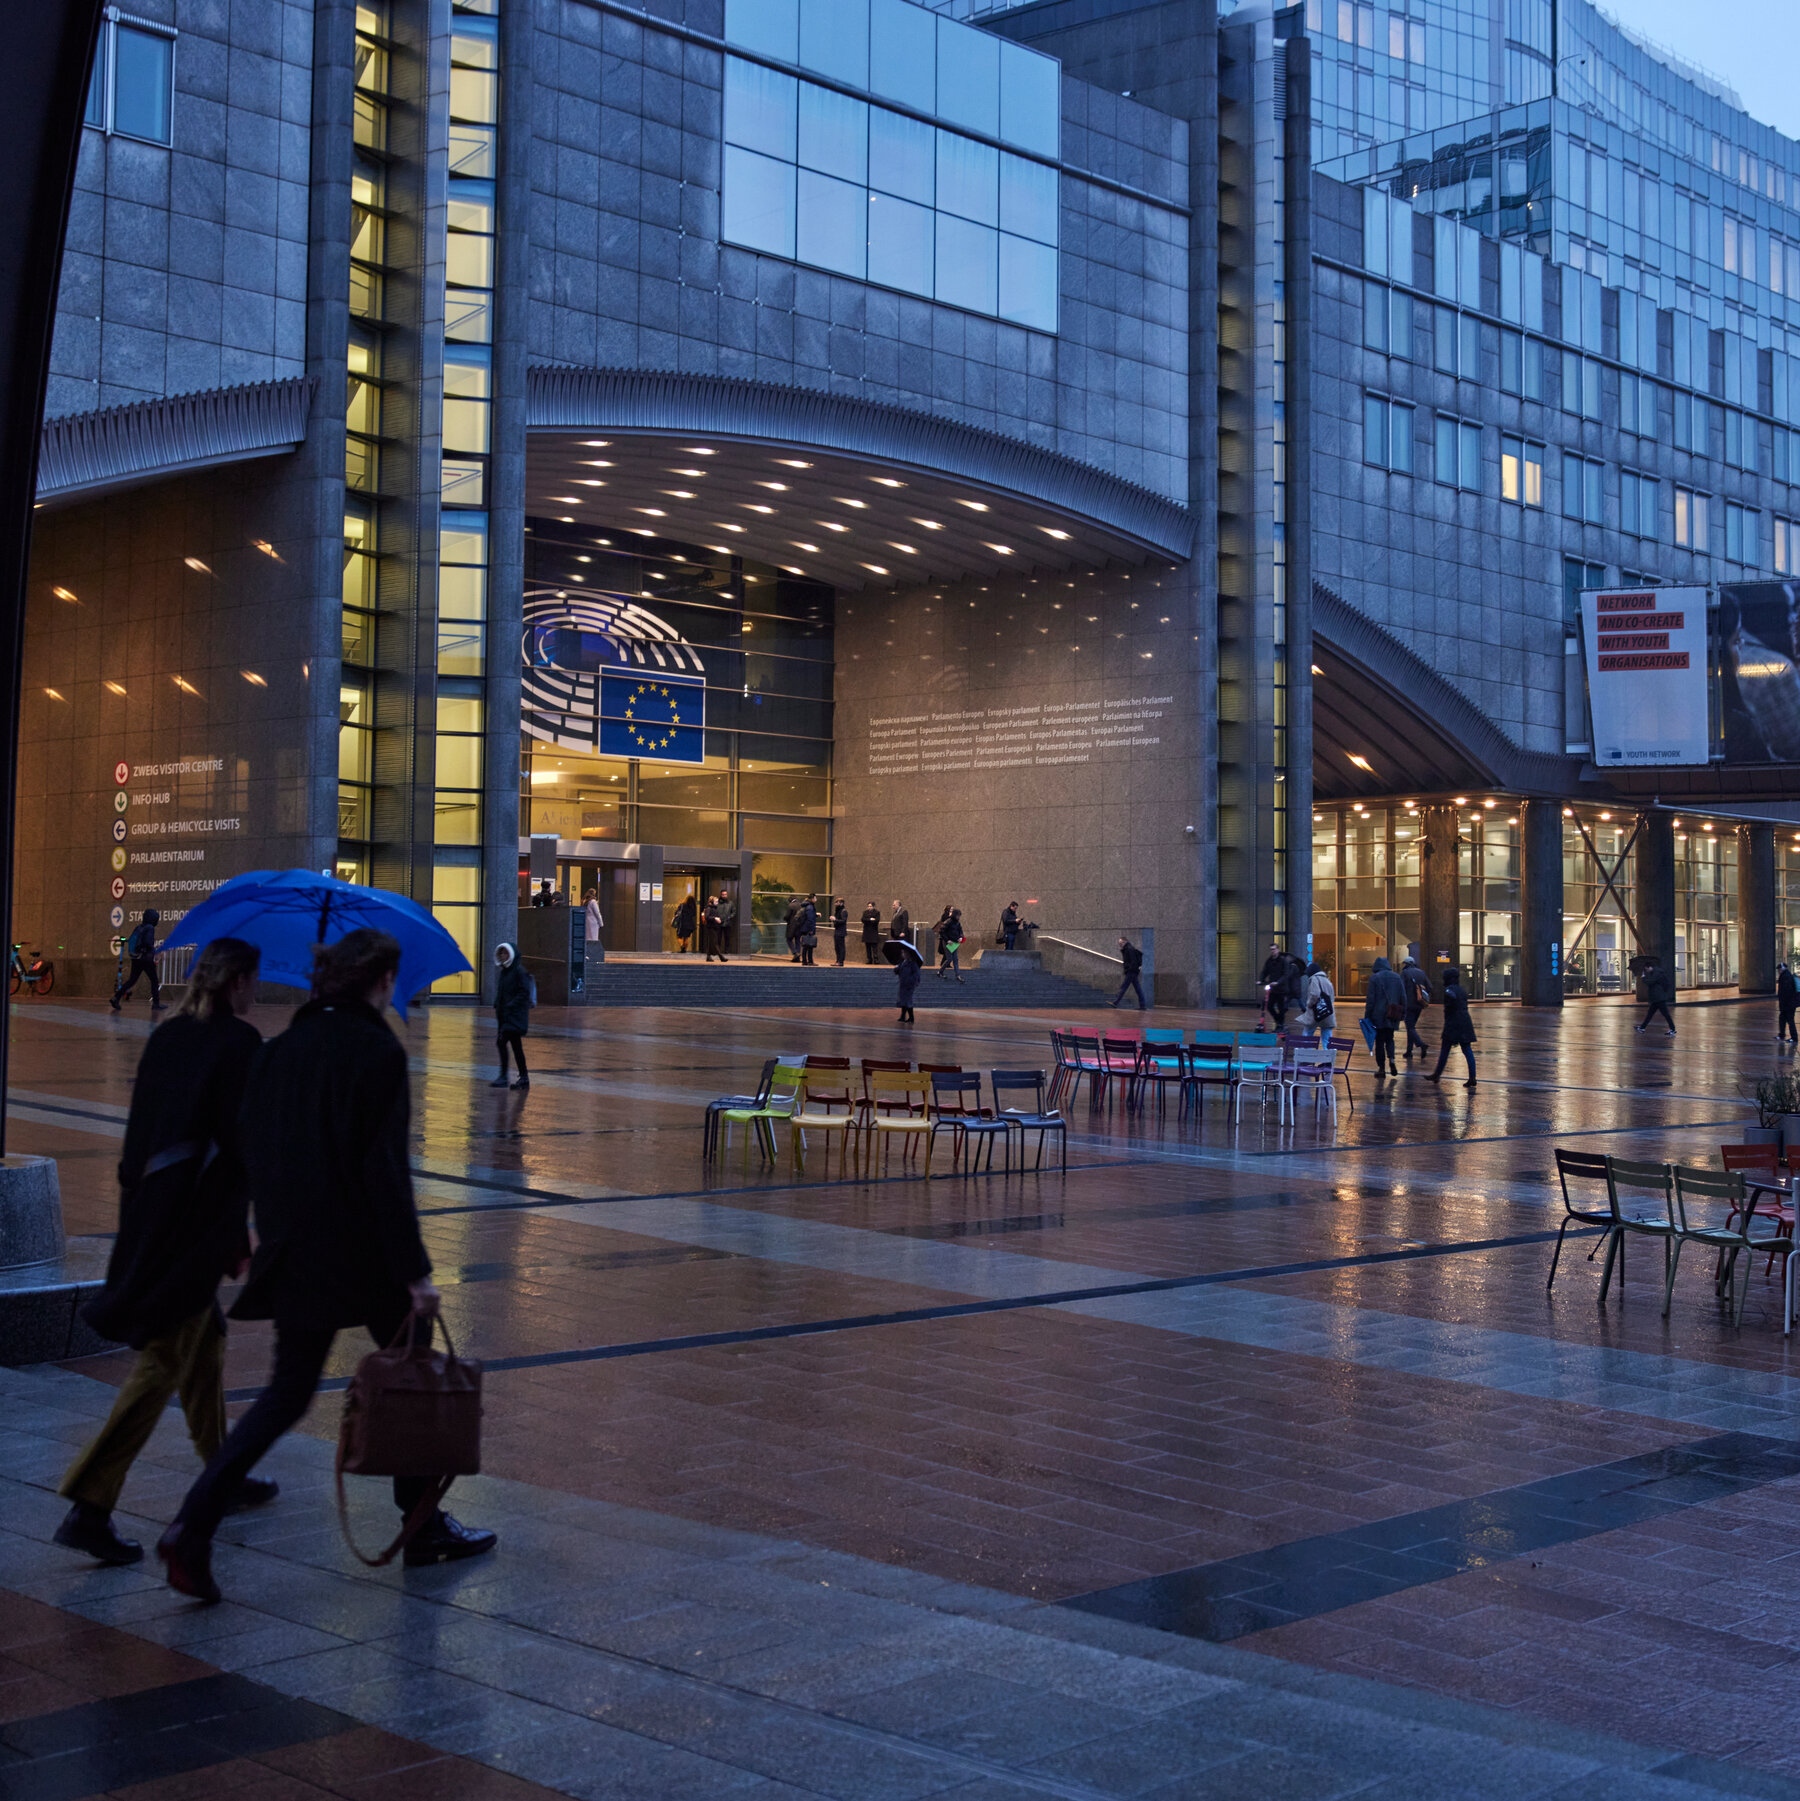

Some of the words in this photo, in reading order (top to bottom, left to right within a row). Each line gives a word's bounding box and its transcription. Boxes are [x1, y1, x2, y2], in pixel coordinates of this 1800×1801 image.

[1600, 596, 1653, 609] NETWORK
[1600, 616, 1623, 629] AND
[1625, 615, 1682, 628] CO-CREATE
[1601, 637, 1629, 649] WITH
[1631, 636, 1667, 648] YOUTH
[1601, 655, 1687, 669] ORGANISATIONS
[1142, 696, 1173, 705] Parlament
[1012, 705, 1040, 717] parlament
[1043, 702, 1100, 712] Europa-Parlamentet
[983, 721, 1008, 731] European
[1009, 718, 1038, 728] Parliament
[1114, 724, 1144, 734] Parlament
[891, 728, 917, 737] Parlament
[1052, 728, 1087, 738] Parlamentas
[1036, 742, 1068, 751] Parlamento
[1132, 736, 1160, 746] European
[1035, 754, 1089, 765] Europaparlamentet
[1649, 750, 1681, 758] NETWORK
[133, 765, 159, 777] ZWEIG
[160, 762, 190, 775] VISITOR
[191, 759, 223, 772] CENTRE
[944, 760, 971, 771] parlament
[132, 794, 152, 806] INFO
[153, 792, 170, 804] HUB
[131, 823, 159, 835] GROUP
[160, 822, 167, 833] &
[168, 820, 213, 833] HEMICYCLE
[214, 818, 240, 830] VISITS
[130, 850, 204, 864] PARLAMENTARIUM
[129, 881, 158, 893] HOUSE
[158, 880, 169, 892] OF
[170, 880, 214, 892] EUROPEAN
